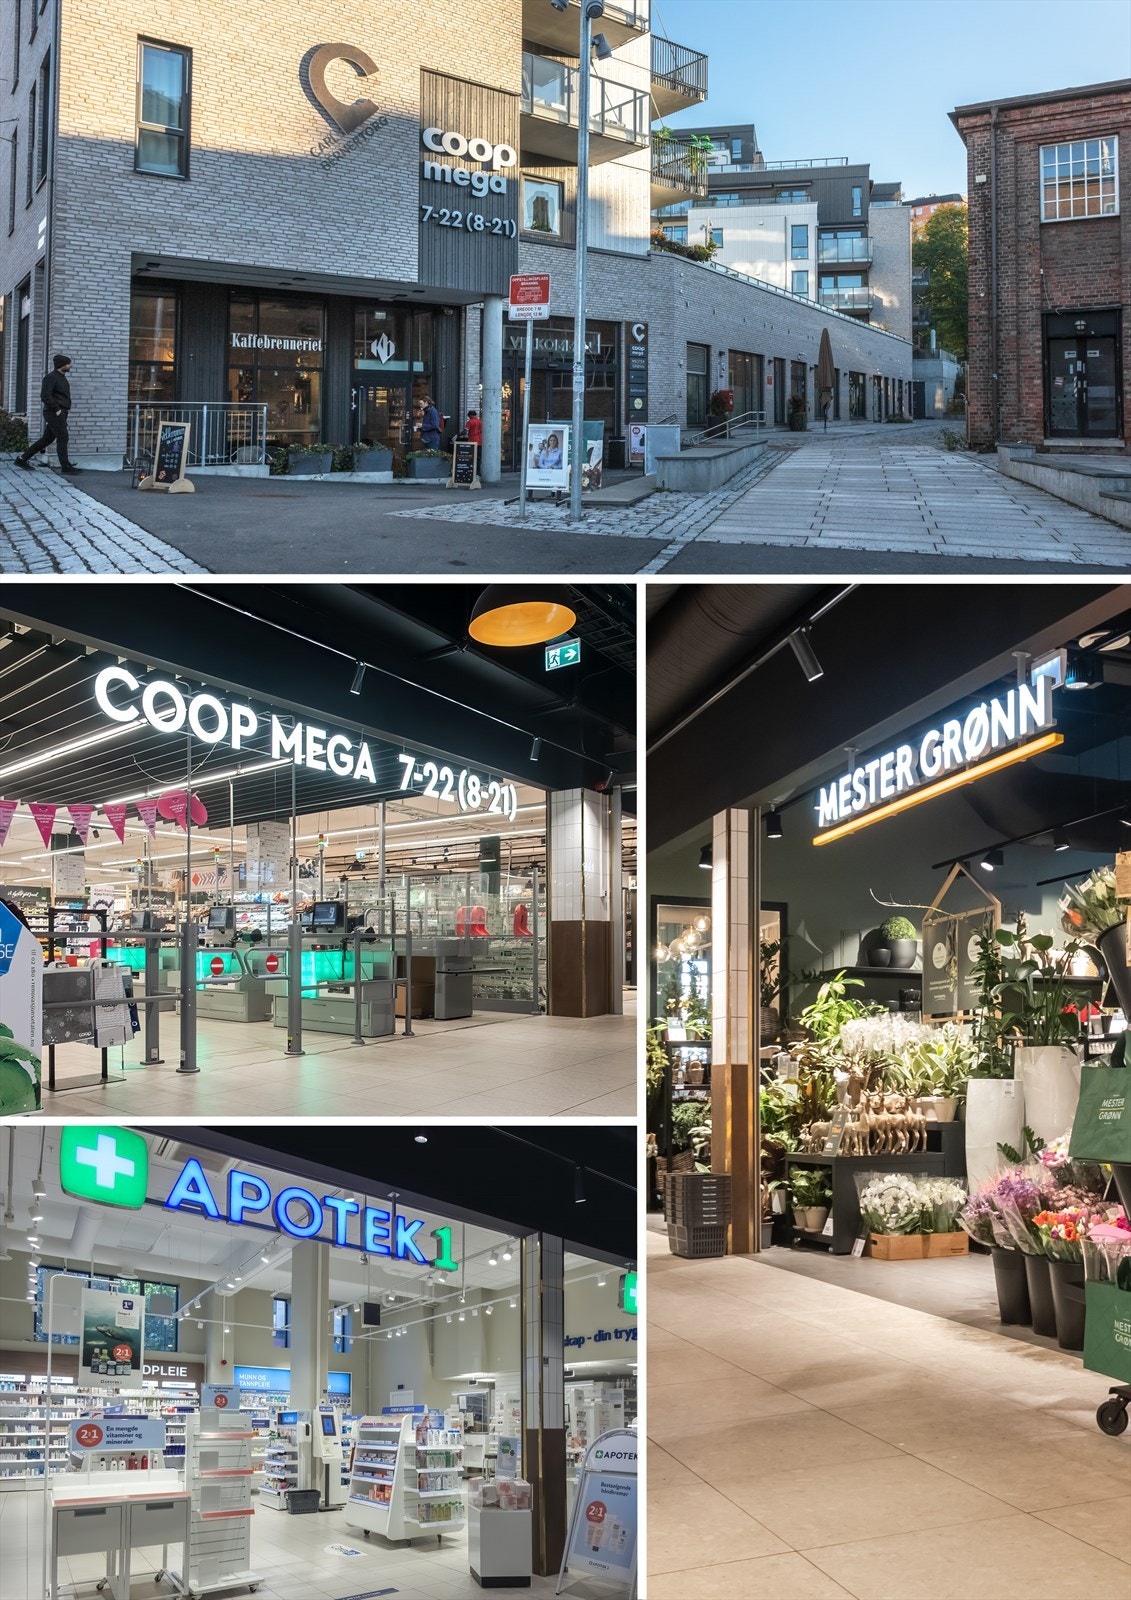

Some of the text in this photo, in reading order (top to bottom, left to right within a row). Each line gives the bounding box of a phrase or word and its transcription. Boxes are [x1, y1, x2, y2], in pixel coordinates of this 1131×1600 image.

[310, 134, 339, 157] CARL
[422, 127, 518, 171] coop
[423, 160, 507, 198] mega
[421, 205, 517, 239] 7-22 (8-21)
[232, 332, 323, 352] Kaffebrenneriet
[94, 666, 518, 823] COOP MEGA 7-22 (8-21)
[817, 675, 1050, 828] MESTER GRØNN
[1101, 1098, 1125, 1107] MESTER
[164, 1157, 458, 1272] APOTEK 1
[594, 1329, 612, 1342] din
[239, 1380, 271, 1388] TANNPLEIE
